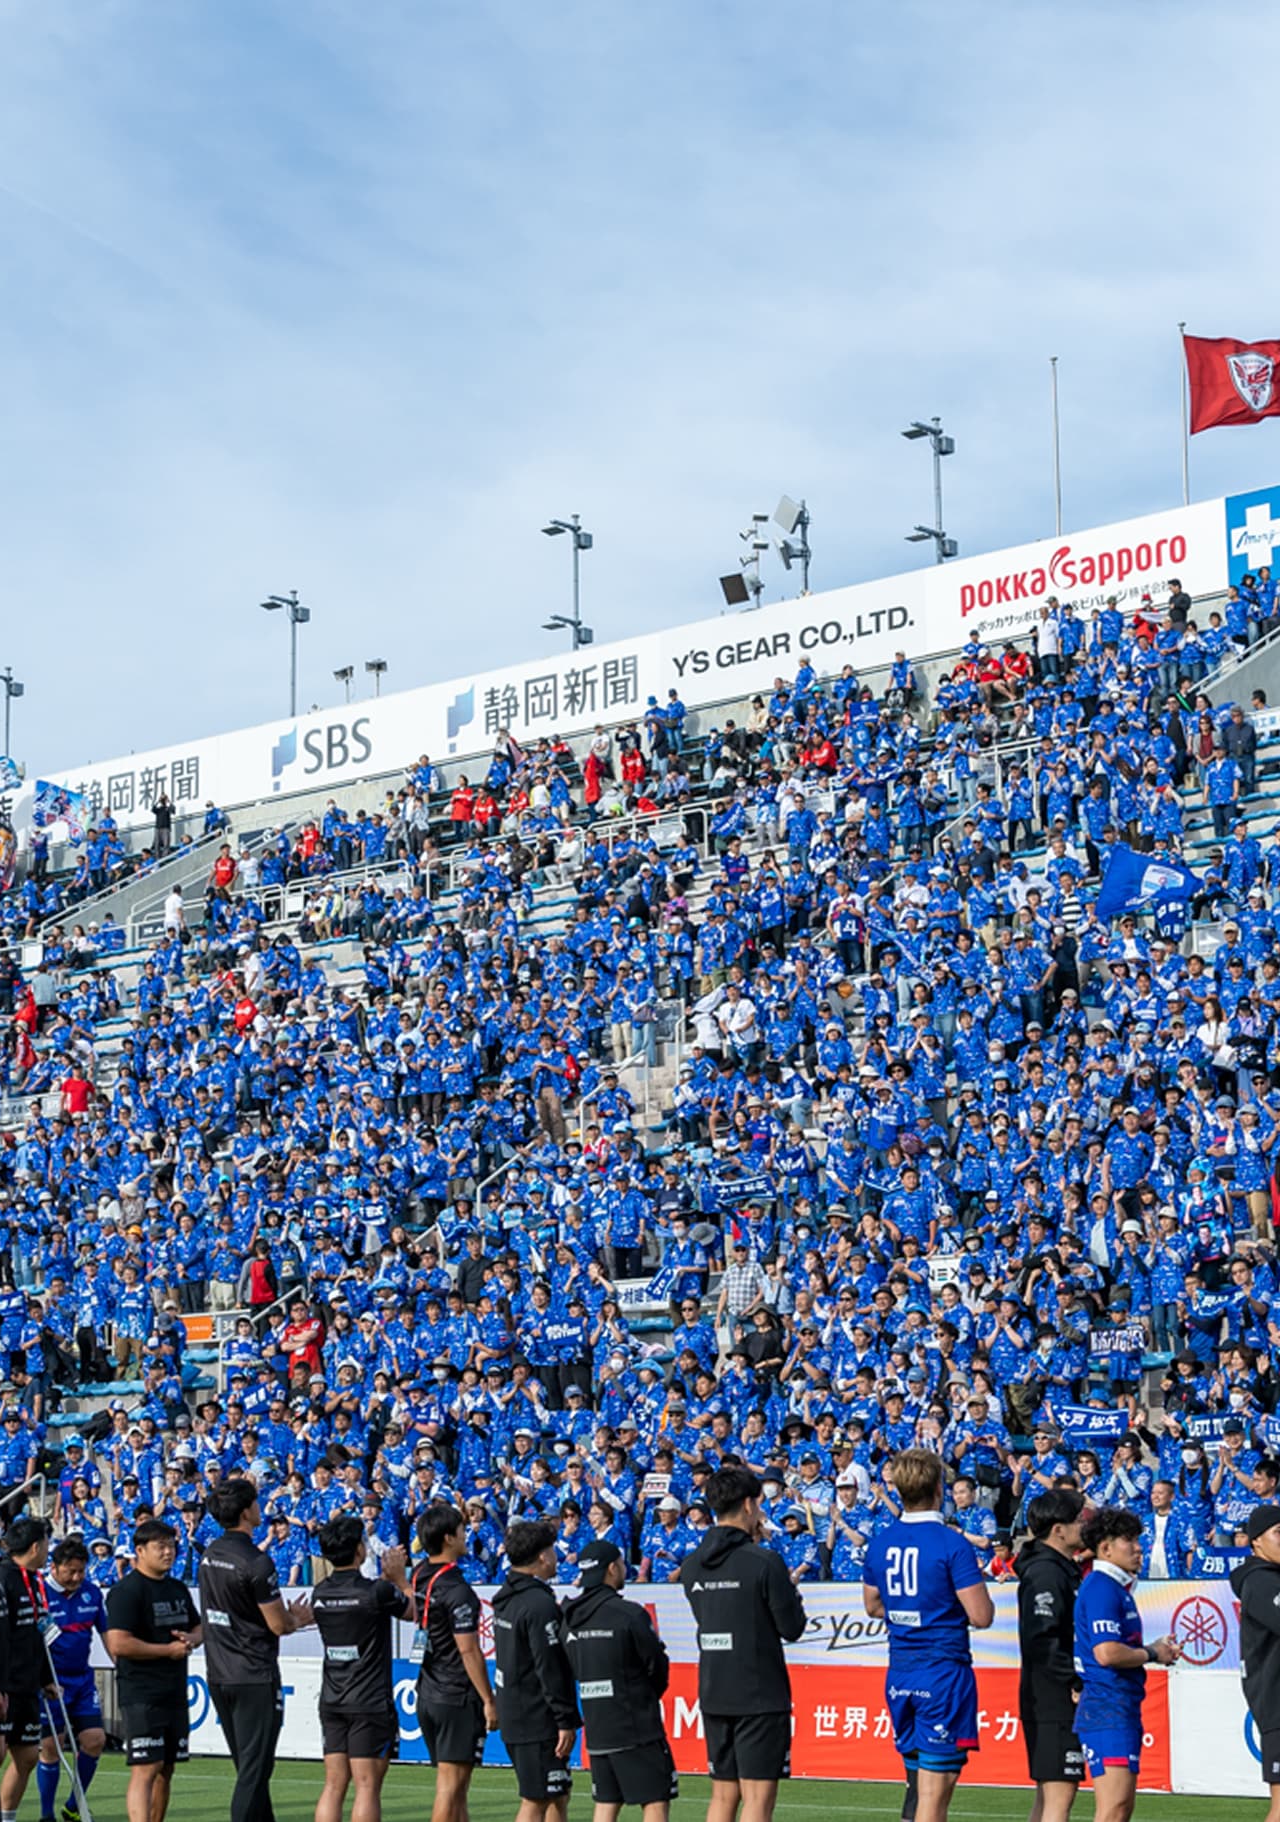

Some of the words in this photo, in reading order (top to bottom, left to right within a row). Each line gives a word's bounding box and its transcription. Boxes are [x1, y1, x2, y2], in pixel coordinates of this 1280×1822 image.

[672, 650, 710, 678] Y'S
[716, 632, 791, 667] GEAR
[484, 655, 639, 735] 静岡新聞
[303, 717, 372, 775] SBS
[886, 1546, 919, 1597] 20
[826, 1613, 888, 1652] You
